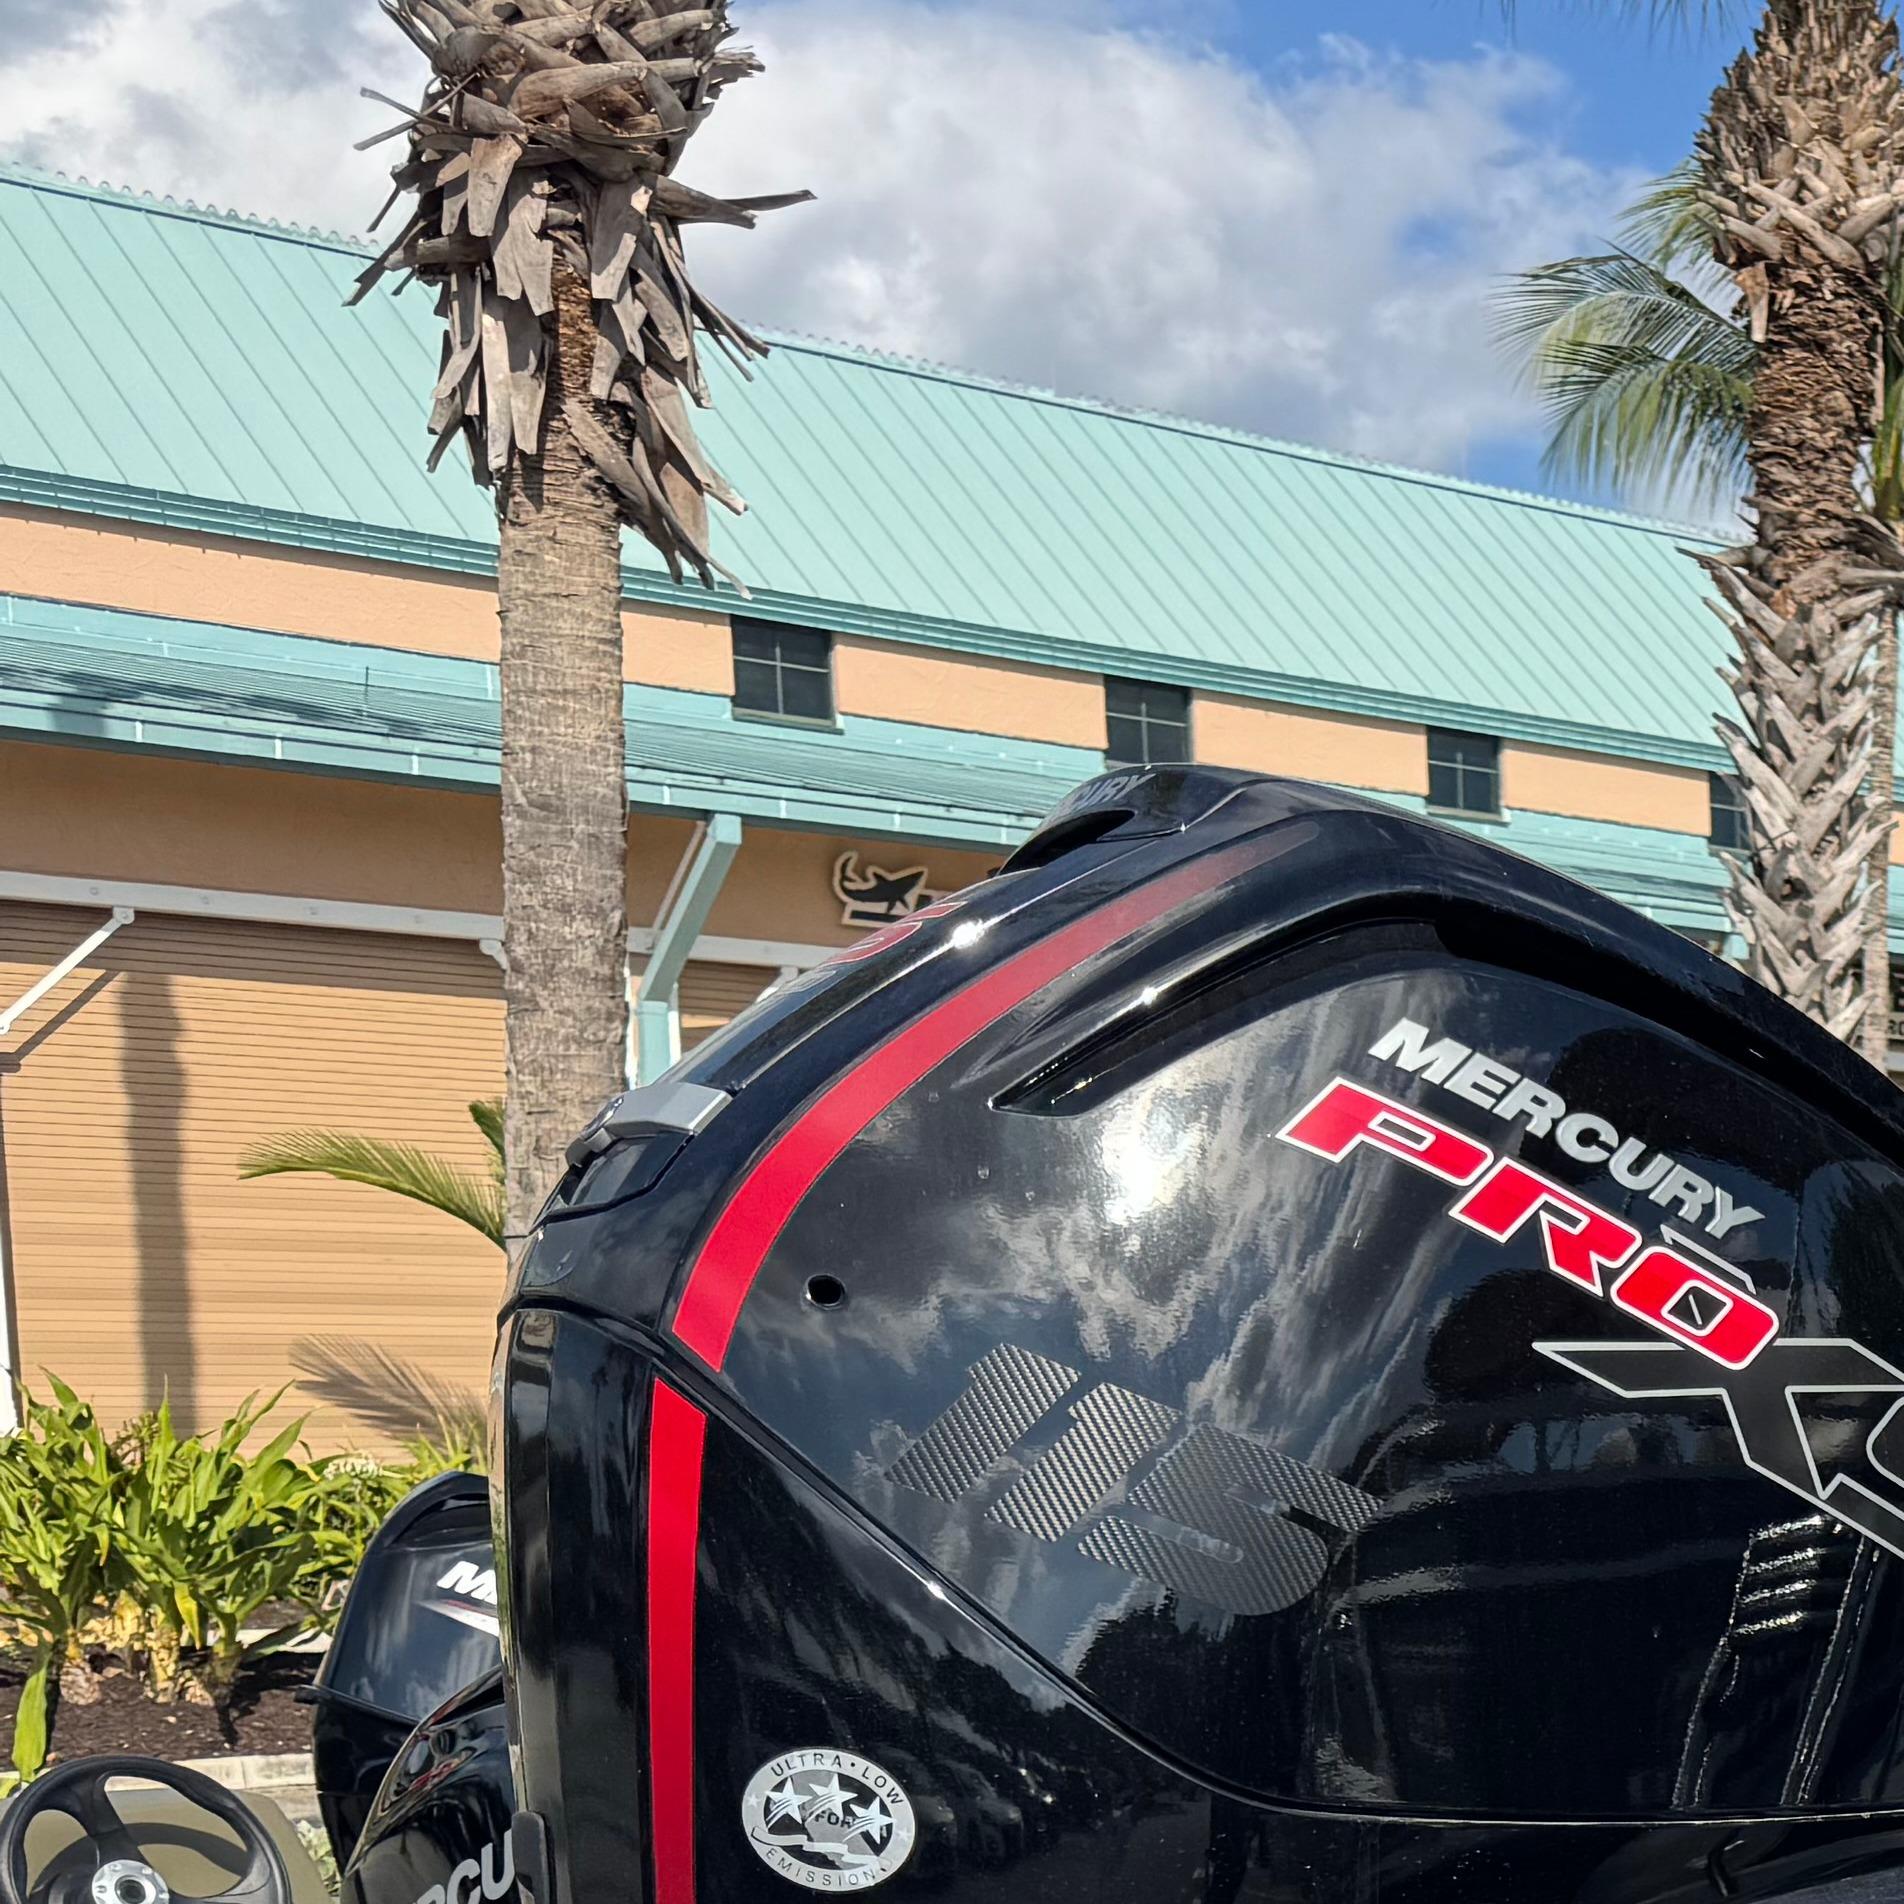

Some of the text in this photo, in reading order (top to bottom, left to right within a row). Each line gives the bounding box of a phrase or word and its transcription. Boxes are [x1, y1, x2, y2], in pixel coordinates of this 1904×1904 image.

[1368, 1017, 1766, 1240] MERCURY
[1275, 1076, 1780, 1371] PRO
[770, 1753, 904, 1805] ULTRA LOW
[766, 1847, 876, 1887] EMISSION
